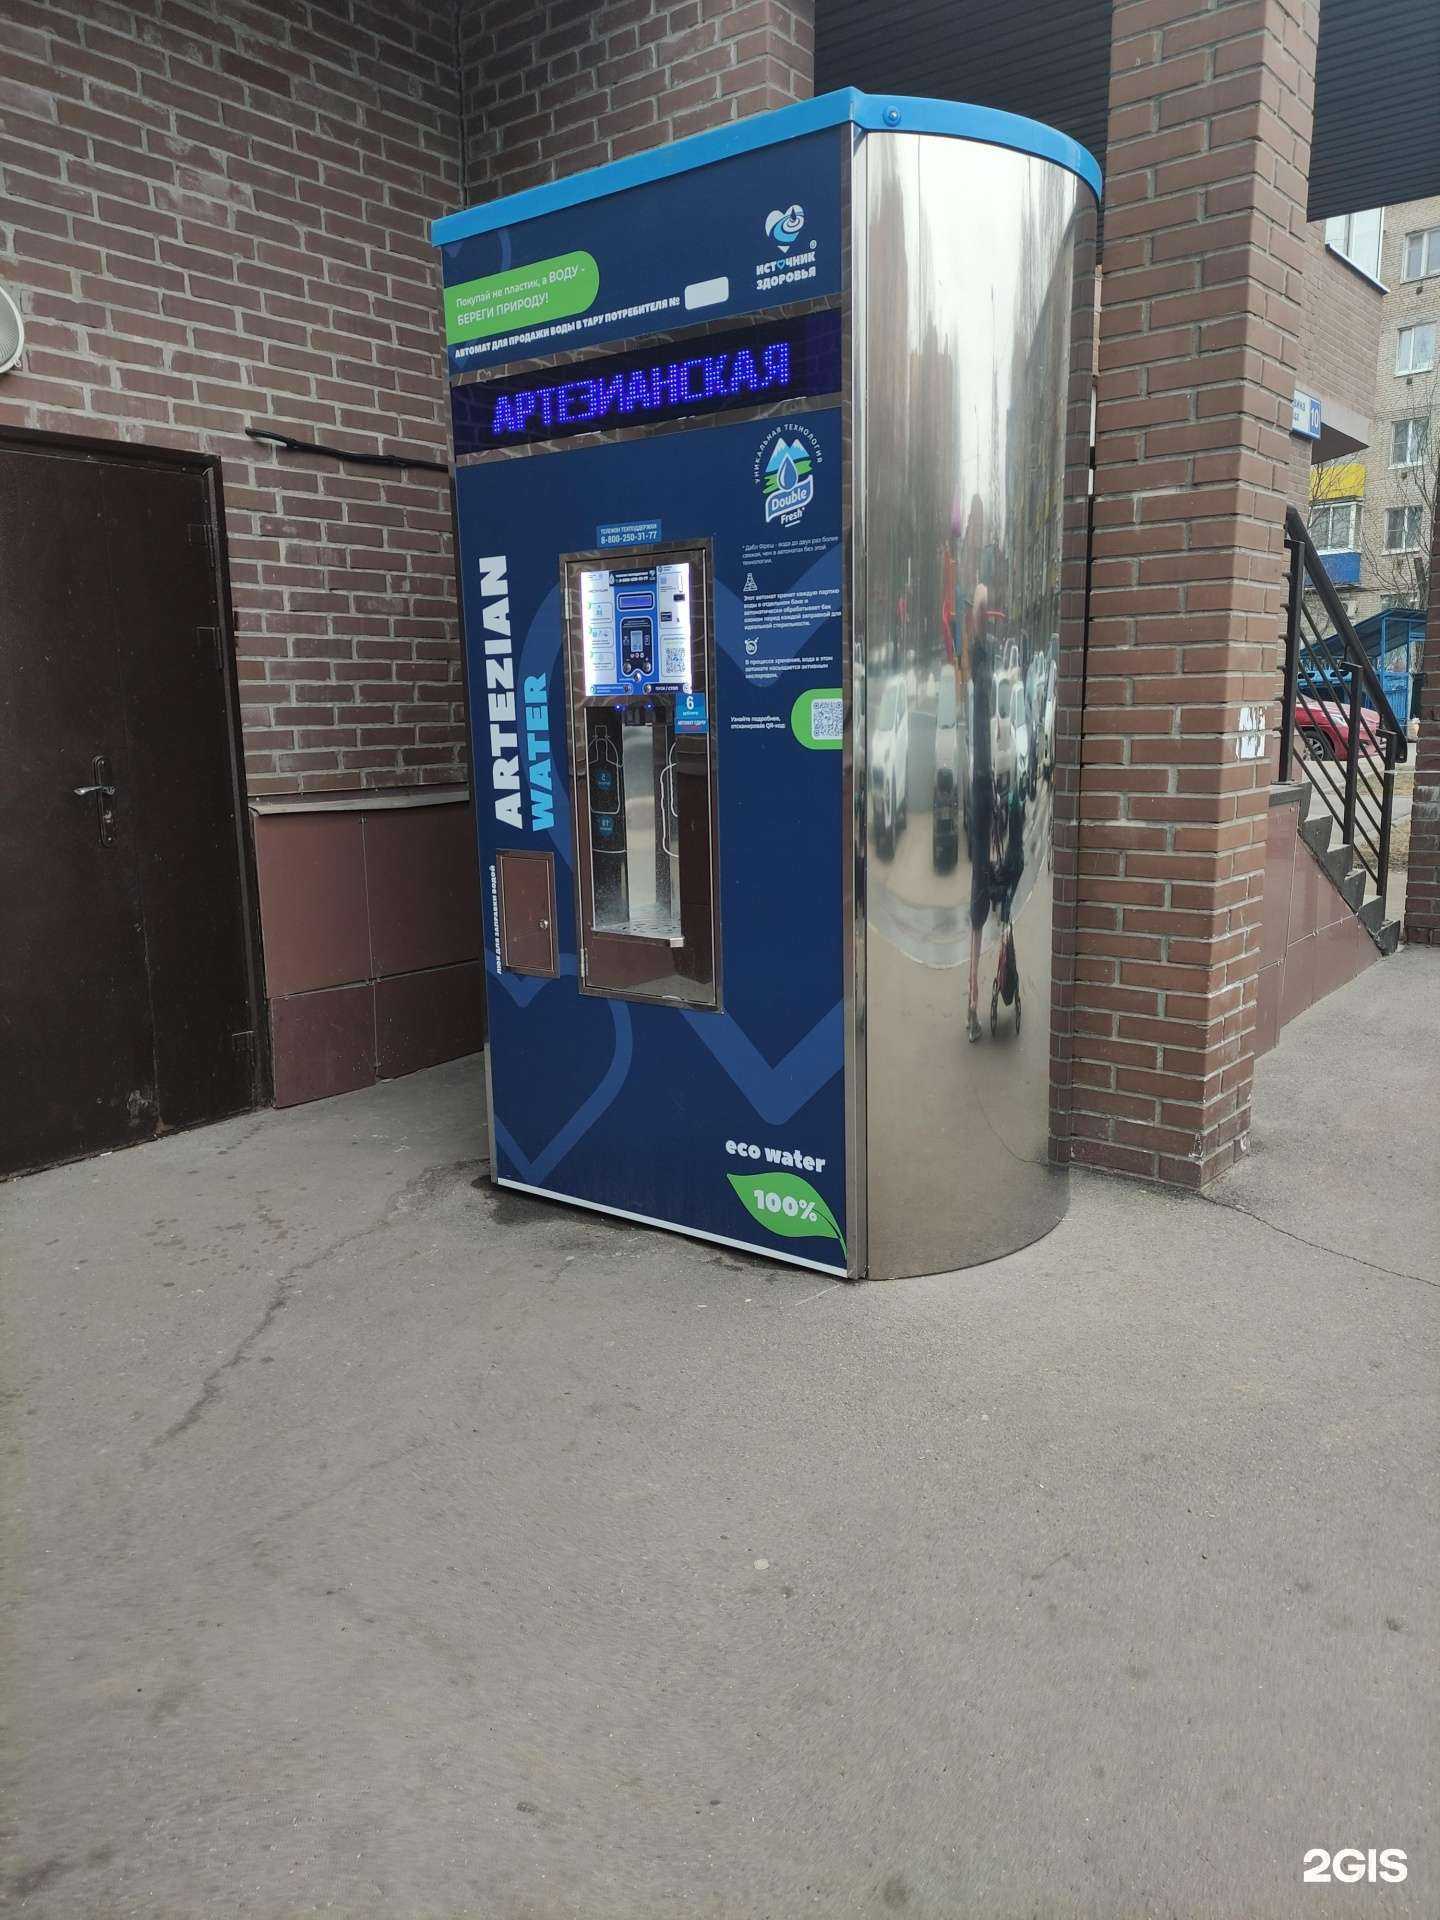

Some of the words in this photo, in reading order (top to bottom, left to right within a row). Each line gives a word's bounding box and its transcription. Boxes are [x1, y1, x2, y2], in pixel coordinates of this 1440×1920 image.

[456, 291, 491, 308] Покупай
[492, 289, 503, 298] не
[542, 277, 547, 285] а
[549, 264, 579, 283] ВОДУ
[756, 266, 816, 290] ЗДОРОВЬЯ
[457, 306, 494, 326] БЕРЕГИ
[496, 292, 549, 316] ПРИРОДУ!
[455, 342, 491, 358] АВТОМАТ
[491, 338, 508, 350] ДЛЯ
[509, 326, 550, 346] ПРОДАЖИ
[550, 322, 575, 336] ВОДЫ
[576, 320, 582, 330] В
[583, 314, 604, 328] ТАРУ
[605, 299, 668, 322] ПОТРЕБИТЕЛЯ
[491, 343, 789, 433] АРТЕЗИАНСКАЯ
[1311, 407, 1319, 428] 10
[754, 425, 782, 484] УНИКАЛЬНАЯ
[784, 423, 823, 463] ТЕХНОЛОГИЯ
[771, 488, 807, 511] Double
[600, 531, 657, 544] 8-800-250-31-77
[478, 555, 523, 830] ARTEZIAN
[686, 696, 694, 710] 6
[524, 672, 555, 832] WATER
[489, 865, 497, 894] ВОДОЙ
[725, 1140, 761, 1160] eco
[764, 1148, 826, 1172] water
[753, 1189, 818, 1222] 100%
